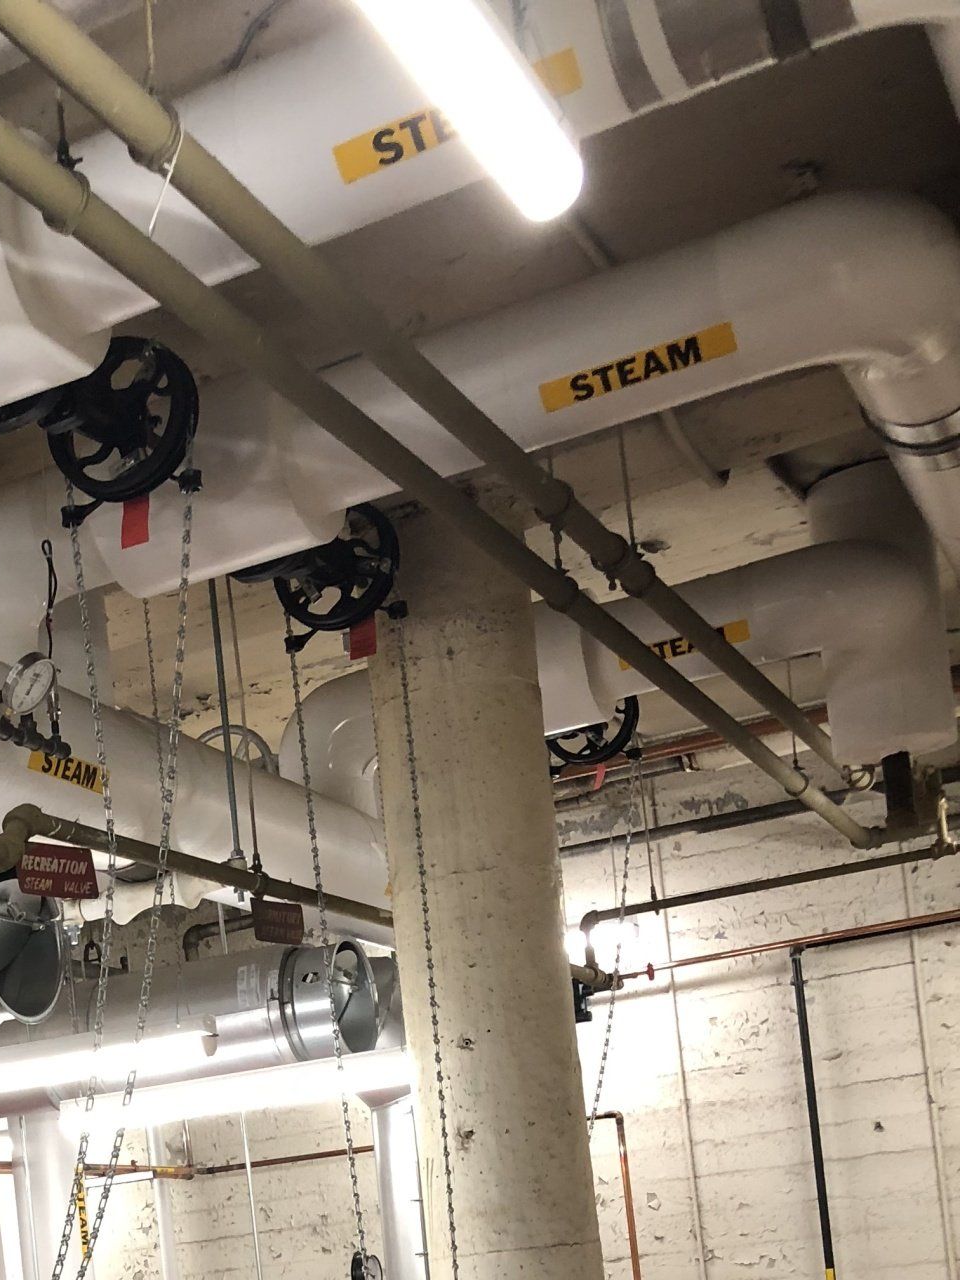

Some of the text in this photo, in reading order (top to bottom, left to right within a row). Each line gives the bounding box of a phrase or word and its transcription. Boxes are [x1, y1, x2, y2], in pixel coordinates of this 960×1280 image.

[570, 335, 703, 402] STEAM
[41, 752, 98, 790] STEAM
[21, 854, 88, 875] RECREATION
[24, 876, 93, 895] STEAM VALVE
